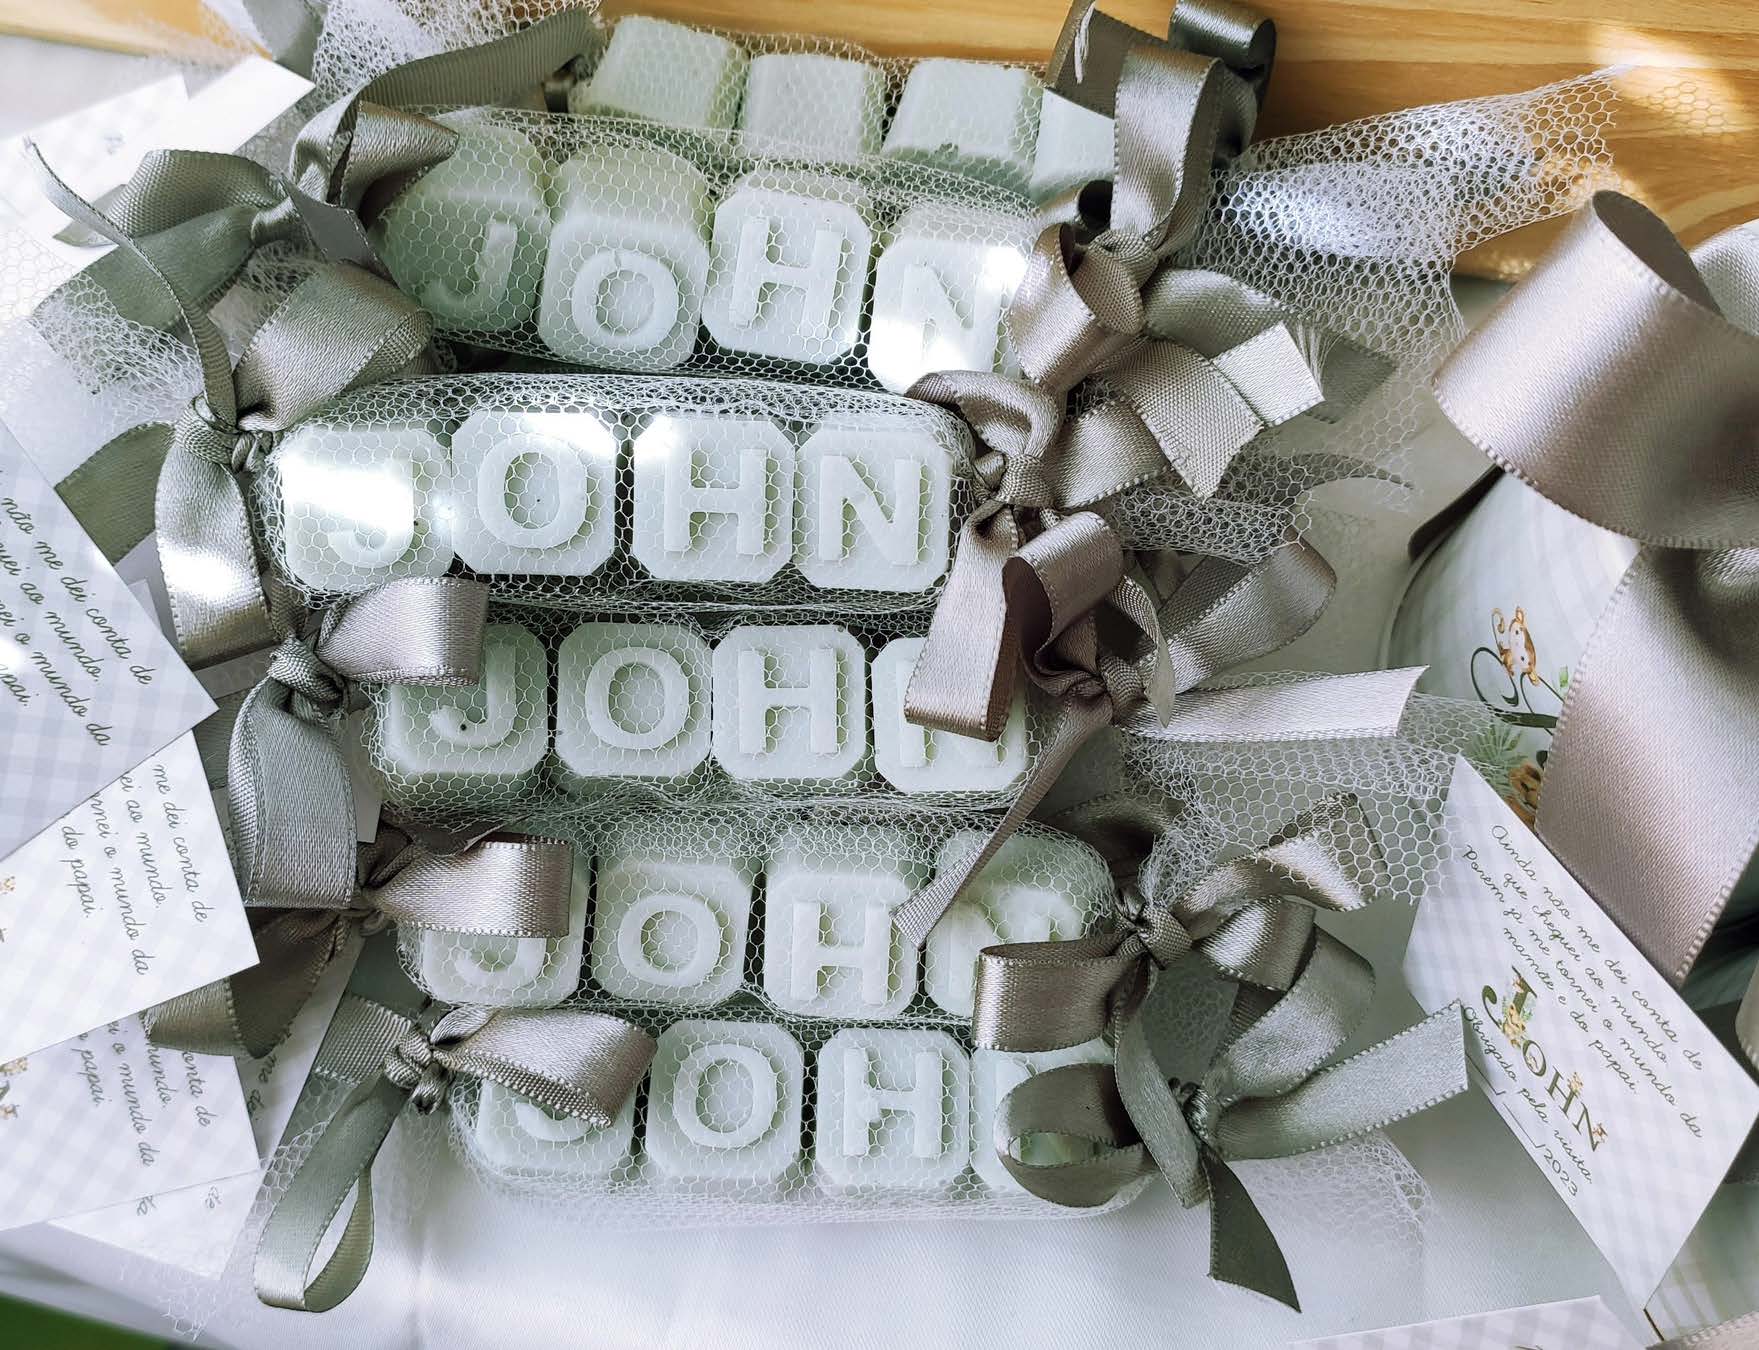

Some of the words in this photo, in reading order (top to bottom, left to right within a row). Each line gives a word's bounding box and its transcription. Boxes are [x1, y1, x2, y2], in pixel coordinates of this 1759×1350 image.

[328, 433, 922, 568] JOHN
[1, 498, 34, 534] não
[34, 541, 64, 570] me
[61, 577, 96, 602] dei
[86, 608, 132, 659] conta
[130, 665, 156, 685] de
[20, 582, 45, 605] ao
[30, 651, 91, 717] mundo
[86, 723, 113, 746] da
[126, 800, 143, 823] ao
[152, 764, 171, 795] me
[163, 802, 188, 829] dei
[62, 825, 84, 850] do
[173, 837, 199, 893] conta
[111, 867, 146, 941] mundo
[132, 949, 156, 975] da
[192, 900, 214, 923] de
[1491, 825, 1536, 881] Ainda
[1577, 926, 1600, 952] me
[1605, 959, 1631, 985] dei
[1632, 990, 1679, 1043] conta
[1683, 1049, 1702, 1071] de
[1503, 873, 1528, 900] que
[1532, 905, 1583, 961] cheguei
[1585, 967, 1605, 989] ao
[1464, 1006, 1518, 1083] Obrigado
[1519, 1087, 1549, 1124] pela
[1481, 965, 1608, 1152] JOHN
[1528, 929, 1551, 955] me
[1556, 960, 1599, 1013] tornei
[1620, 1037, 1677, 1106] mundo
[1680, 1112, 1703, 1138] da
[1570, 1010, 1588, 1032] do
[118, 1063, 153, 1135] mundo
[138, 1142, 161, 1168] da
[182, 1050, 207, 1098] onta
[195, 1105, 219, 1128] de
